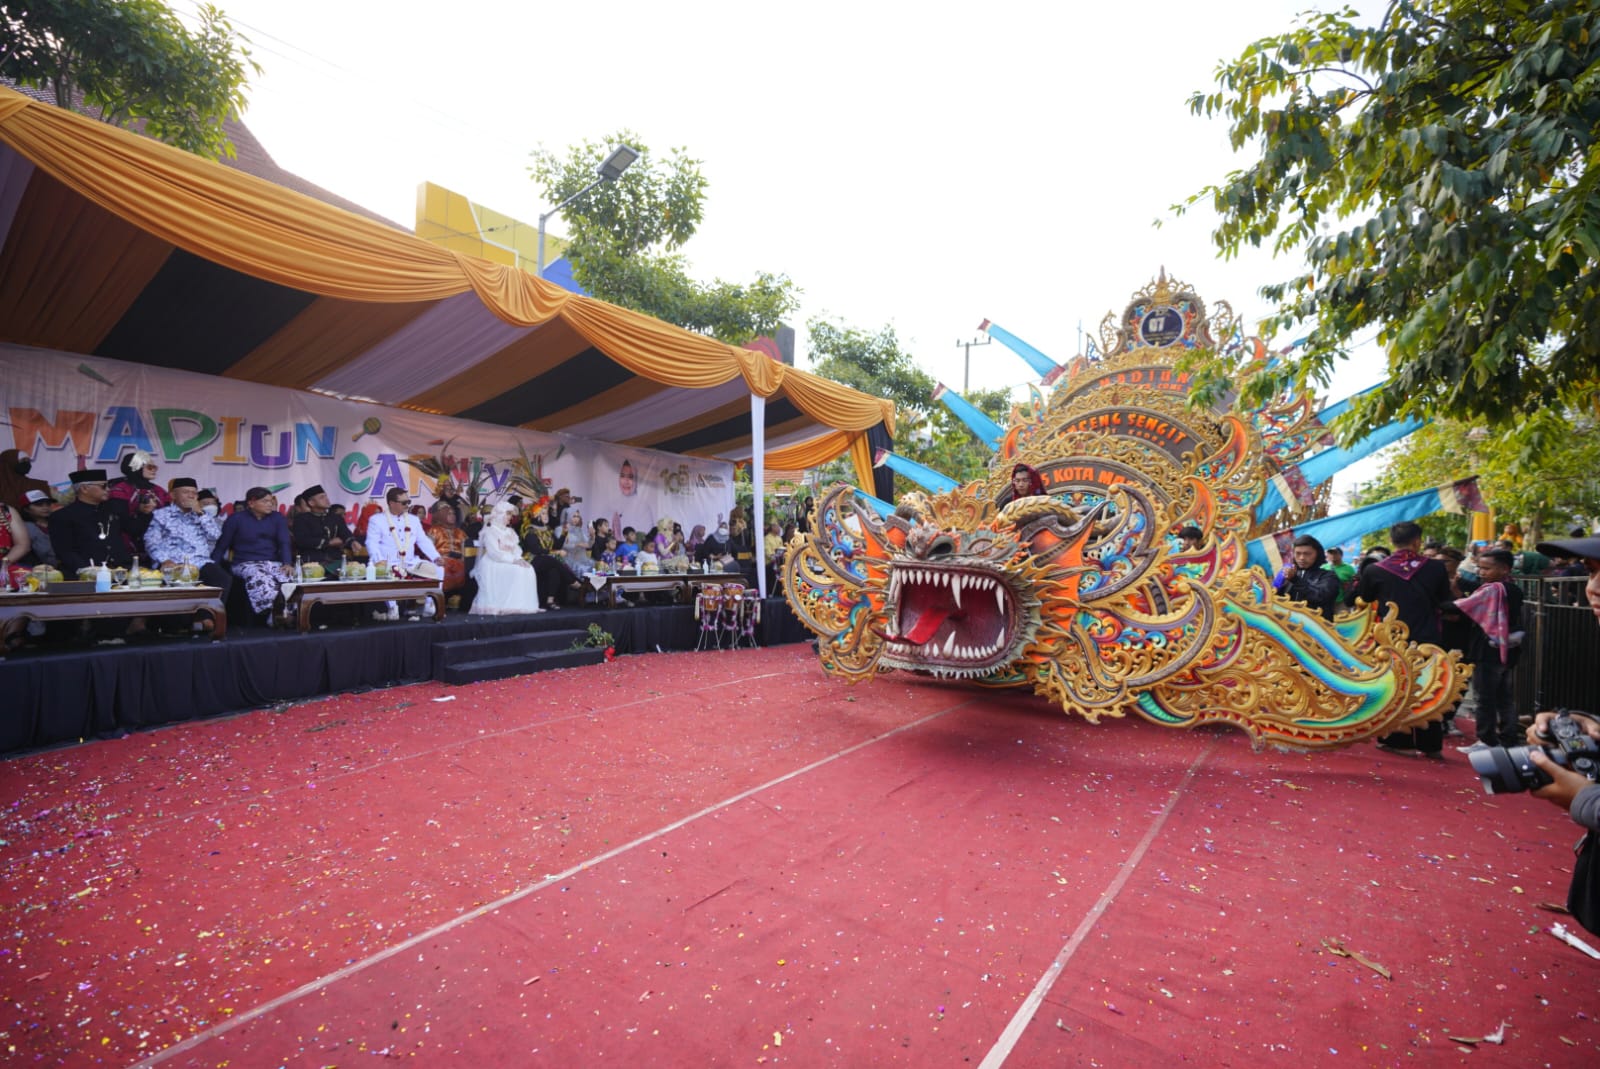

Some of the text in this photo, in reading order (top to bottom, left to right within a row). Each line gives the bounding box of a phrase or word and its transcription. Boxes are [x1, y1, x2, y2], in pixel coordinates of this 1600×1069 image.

[1099, 369, 1190, 387] MADIUN
[8, 405, 338, 470] MADIUN
[1127, 413, 1187, 445] SENGIT
[1053, 466, 1095, 483] KOTA
[1097, 470, 1135, 486] MA
